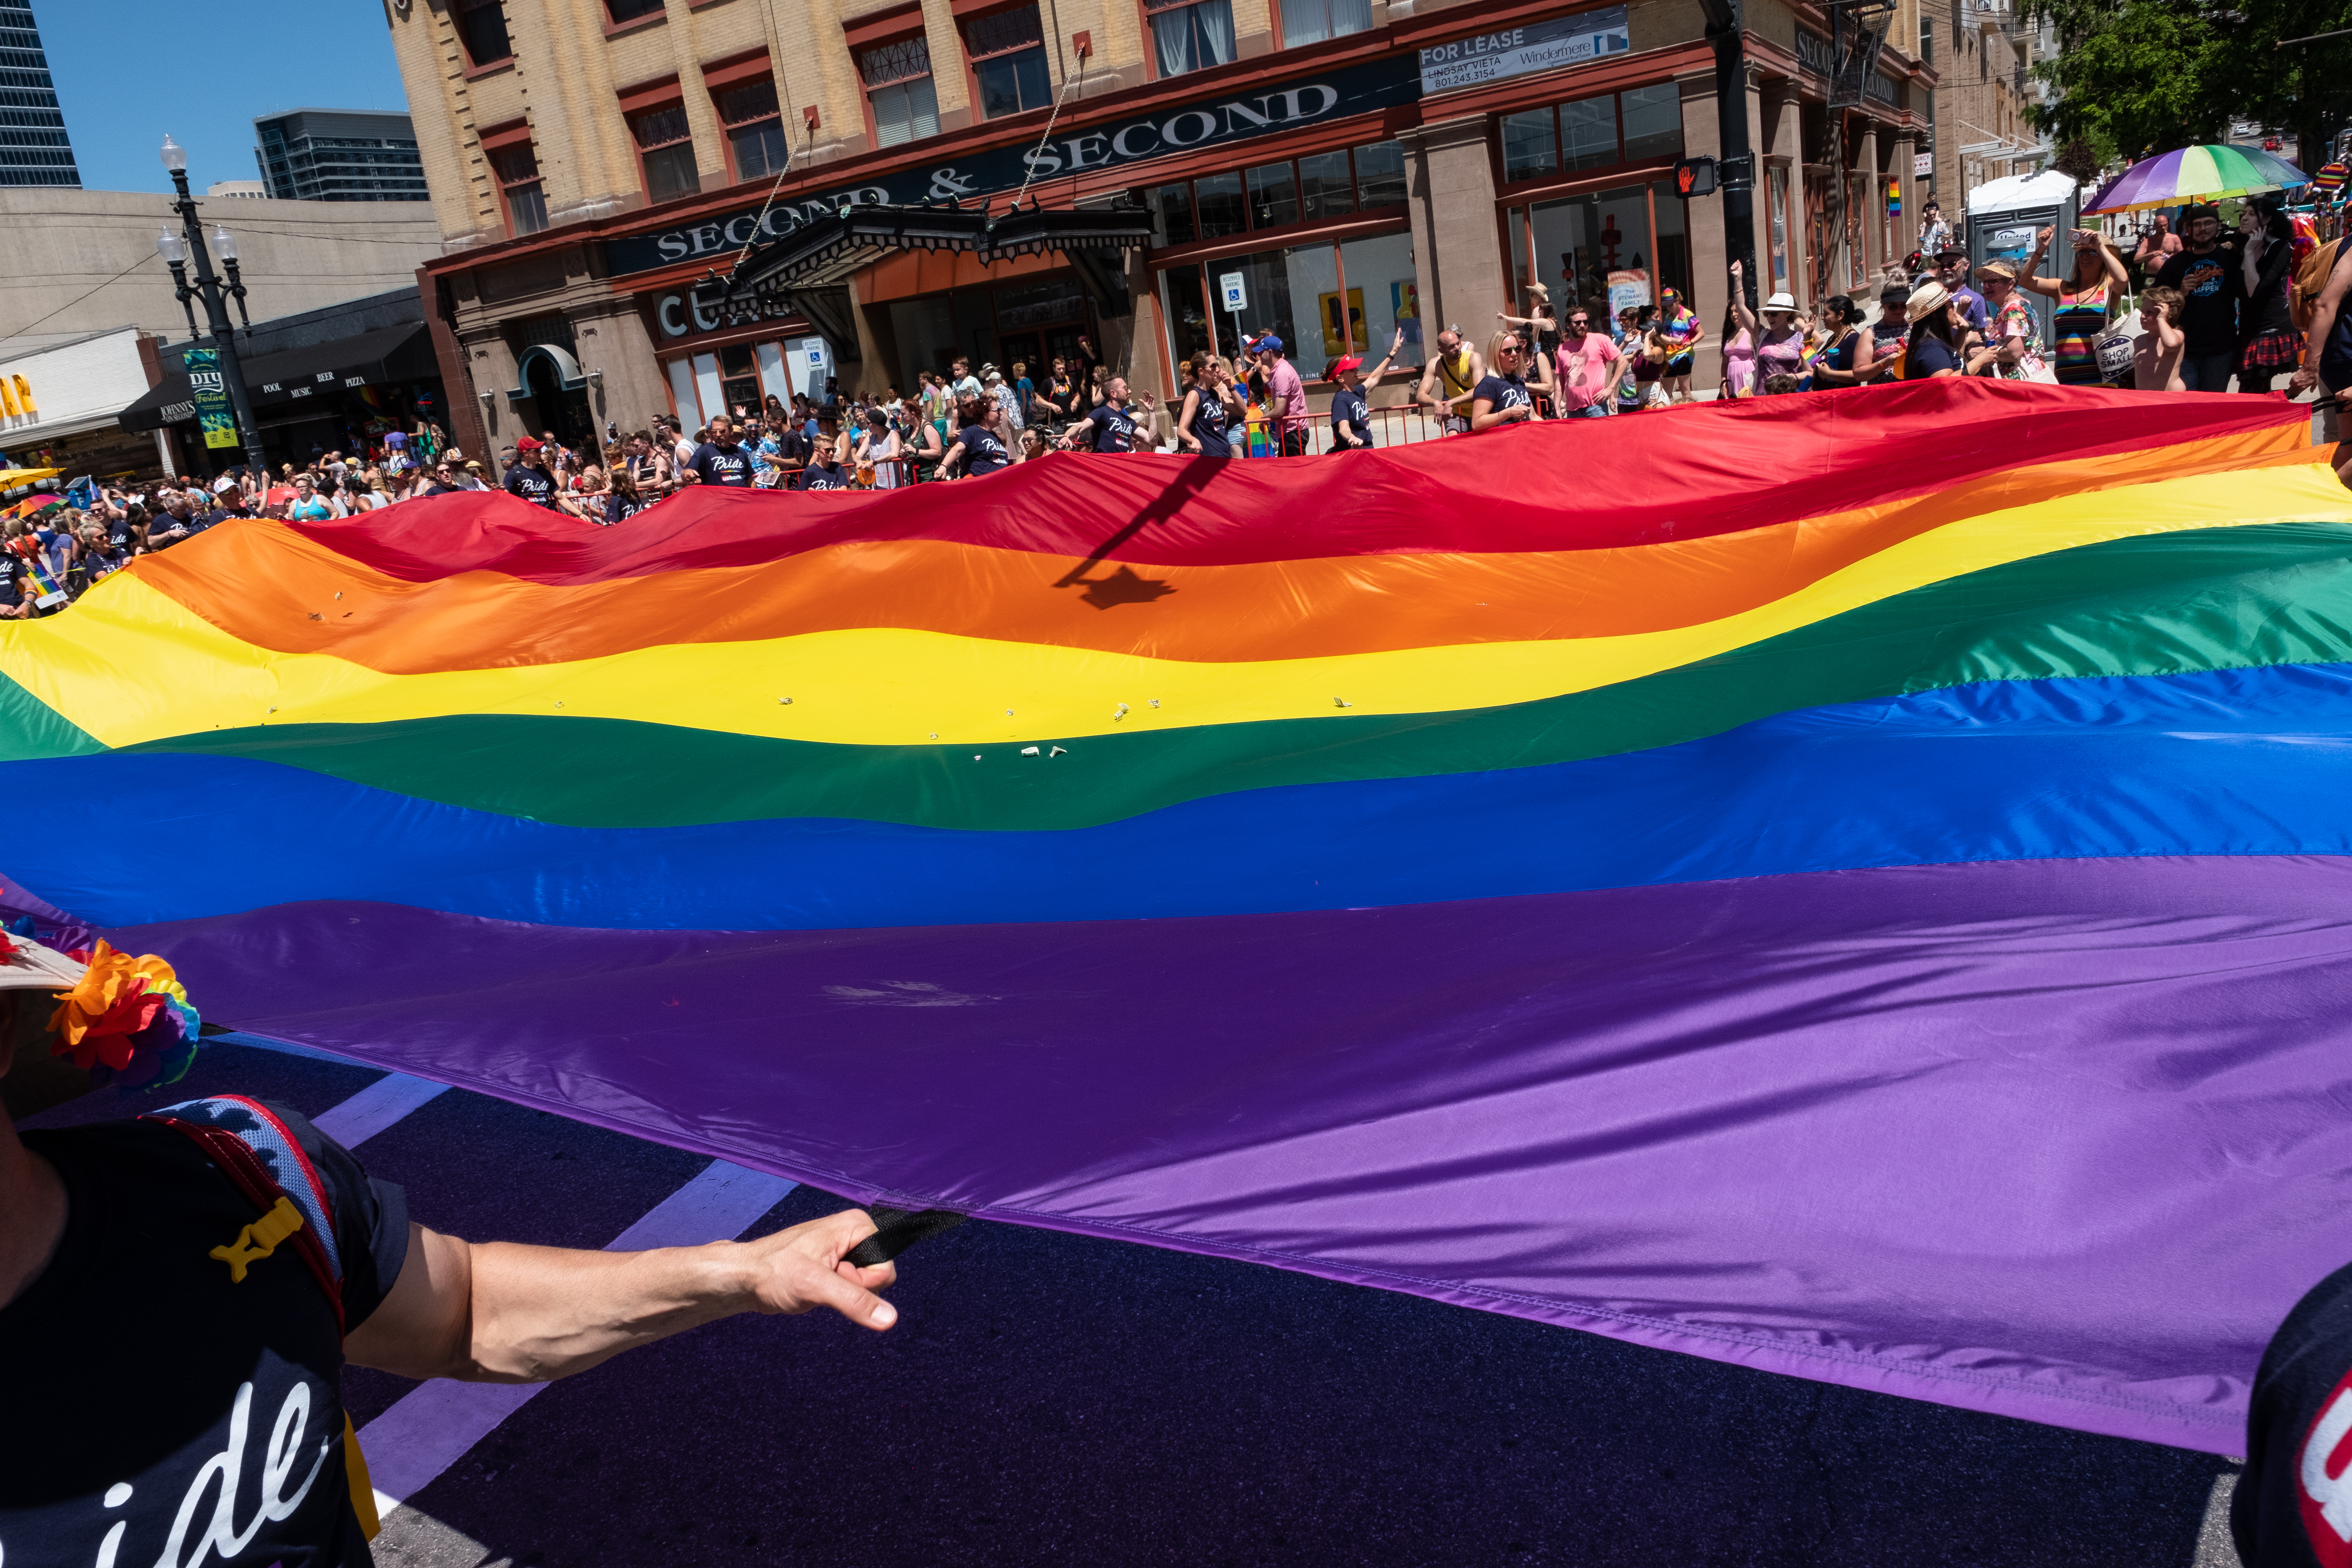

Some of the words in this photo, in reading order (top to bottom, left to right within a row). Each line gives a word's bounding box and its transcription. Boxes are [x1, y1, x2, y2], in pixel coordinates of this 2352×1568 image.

[1421, 44, 1458, 65] FOR
[1465, 29, 1524, 55] LEASE
[1520, 42, 1591, 65] Windermere
[1798, 32, 1833, 72] SECO
[1428, 62, 1471, 79] LINDSAY
[1472, 56, 1501, 69] VIETA
[1435, 68, 1495, 88] 801.243.3154
[1867, 73, 1893, 101] COND
[929, 168, 979, 200] &
[1023, 84, 1338, 179] SECOND
[2101, 354, 2133, 368] SMALL
[2102, 347, 2129, 360] SHOP
[189, 372, 224, 393] DIY
[316, 372, 335, 382] BEER
[345, 376, 365, 387] PIZZA
[0, 373, 37, 417] AR
[195, 392, 227, 403] Festival
[263, 383, 282, 393] POOL
[290, 387, 312, 398] MUSIC
[1503, 388, 1530, 408] Prid
[160, 400, 196, 420] JOHNNY'S
[173, 411, 192, 421] SECOND
[711, 456, 744, 471] Pride
[111, 534, 127, 544] ide
[0, 1382, 329, 1568] ide
